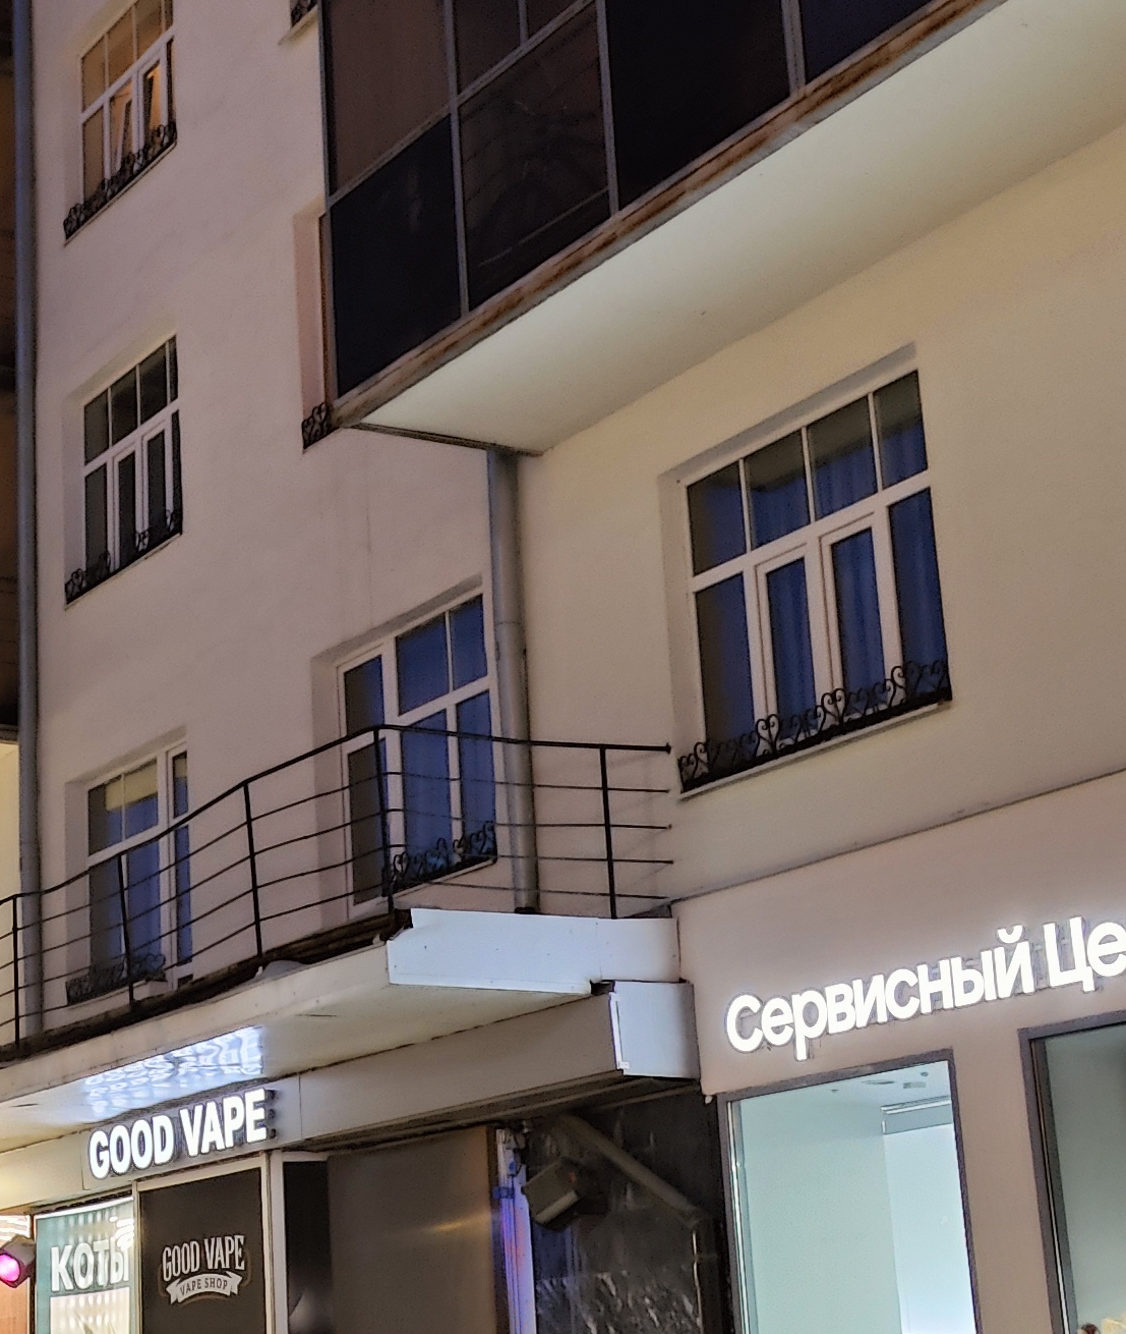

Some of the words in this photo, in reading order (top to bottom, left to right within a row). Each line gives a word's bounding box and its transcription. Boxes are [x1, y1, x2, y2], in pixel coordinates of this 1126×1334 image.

[725, 924, 1036, 1061] Сервисный
[89, 1114, 175, 1179] GOOD
[179, 1088, 267, 1157] VAPE
[50, 1236, 130, 1292] КОТЫ
[162, 1241, 200, 1282] GOOD
[203, 1235, 245, 1271] VAPE
[179, 1280, 202, 1296] VAPE
[204, 1275, 228, 1290] SHOP
